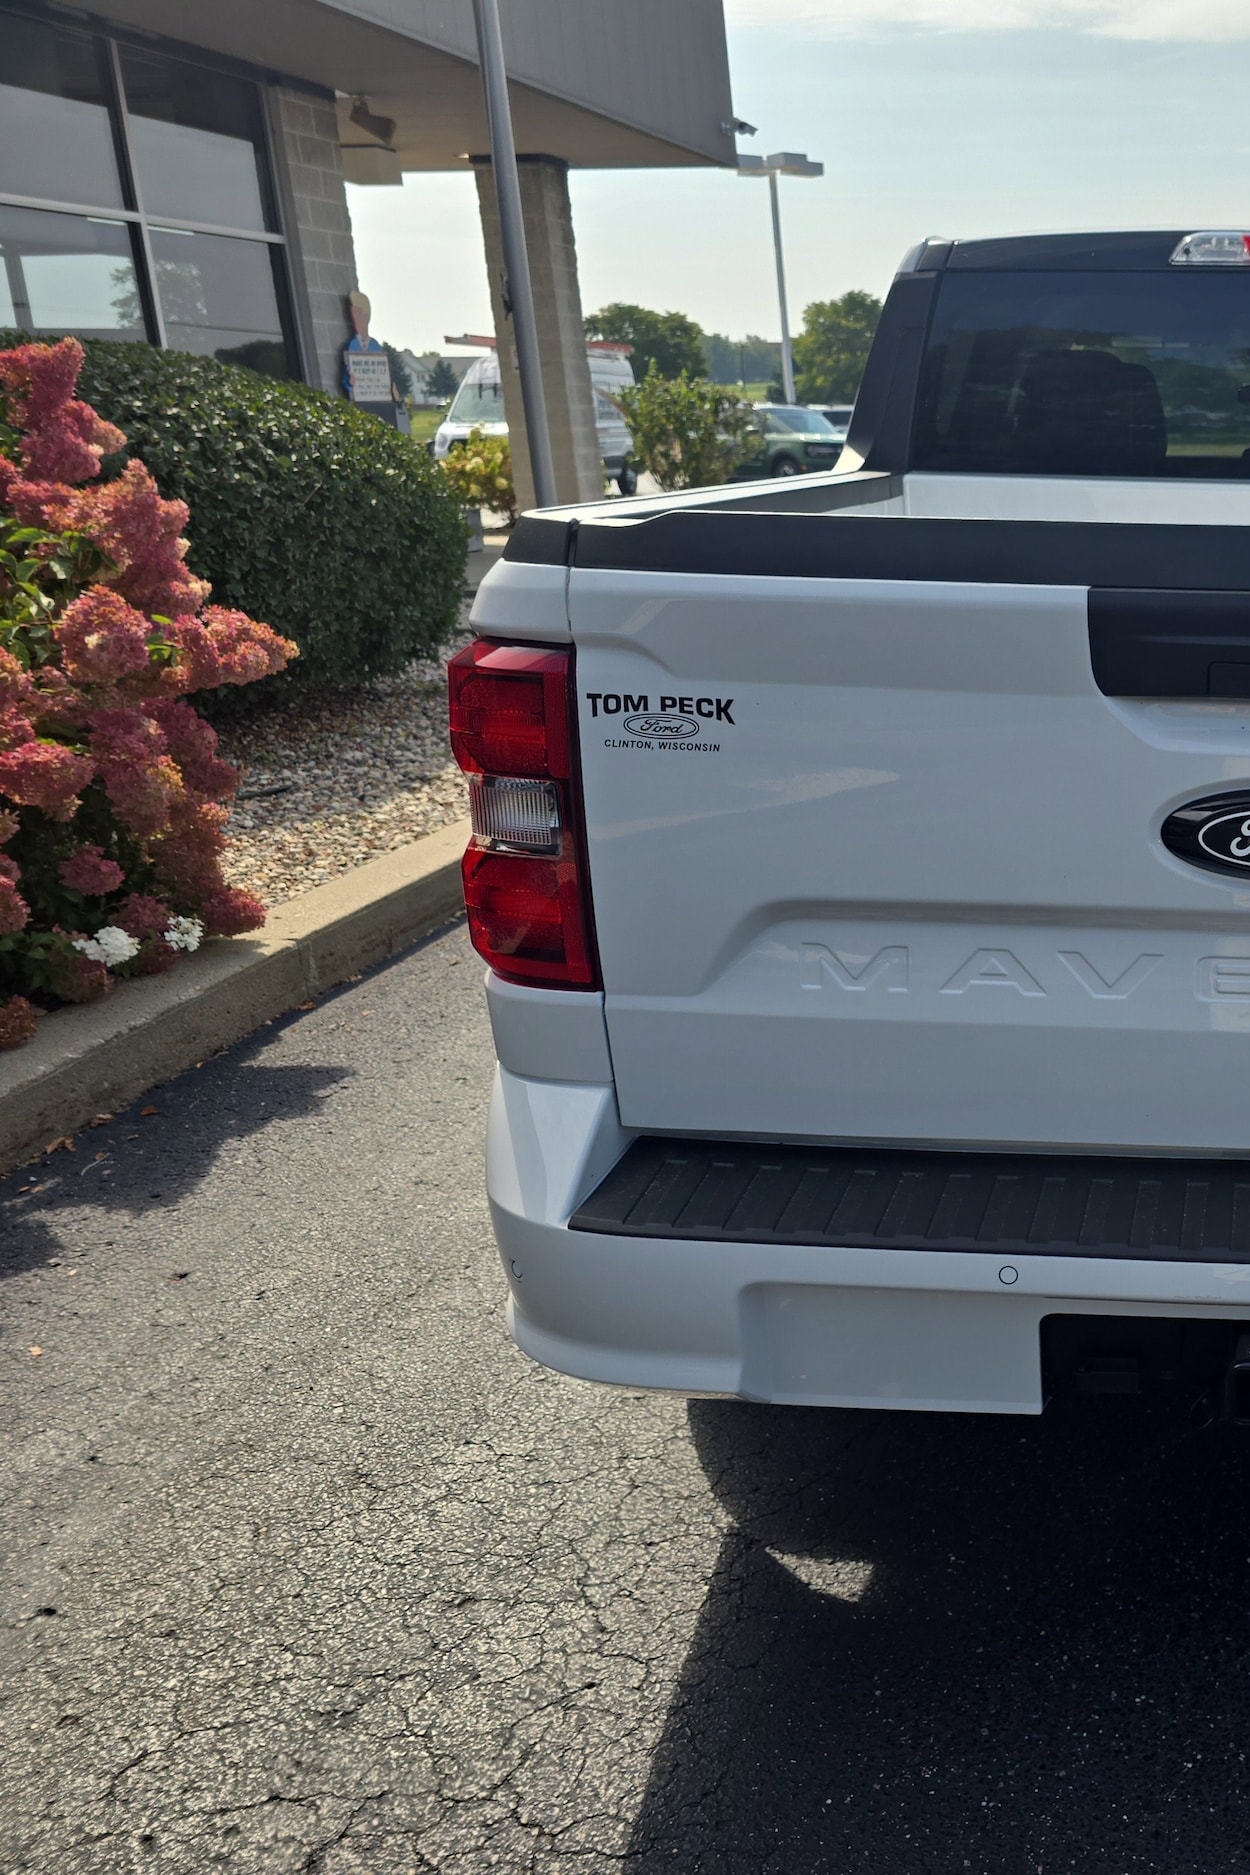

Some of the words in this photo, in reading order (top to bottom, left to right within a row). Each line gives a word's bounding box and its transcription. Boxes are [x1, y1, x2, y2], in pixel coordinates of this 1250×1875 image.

[586, 693, 648, 717] TOM
[660, 696, 735, 725] PECK
[640, 719, 683, 733] Ford
[604, 739, 654, 751] CLINTON,
[658, 742, 720, 752] WISCONSIN
